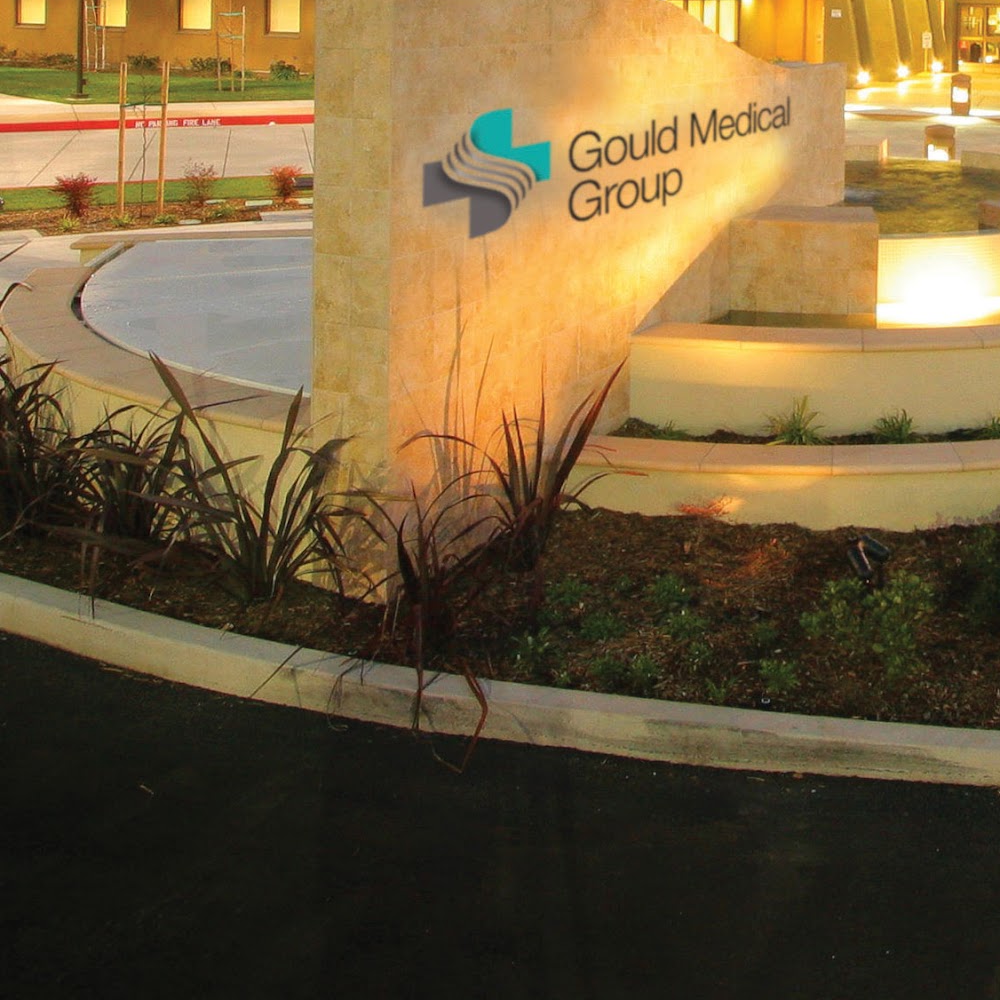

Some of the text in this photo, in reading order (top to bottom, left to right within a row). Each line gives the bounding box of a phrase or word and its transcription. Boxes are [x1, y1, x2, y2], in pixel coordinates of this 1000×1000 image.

[182, 118, 200, 127] FIRE
[201, 117, 222, 127] LANE
[568, 96, 791, 172] Gould Medical
[568, 167, 683, 222] Group
